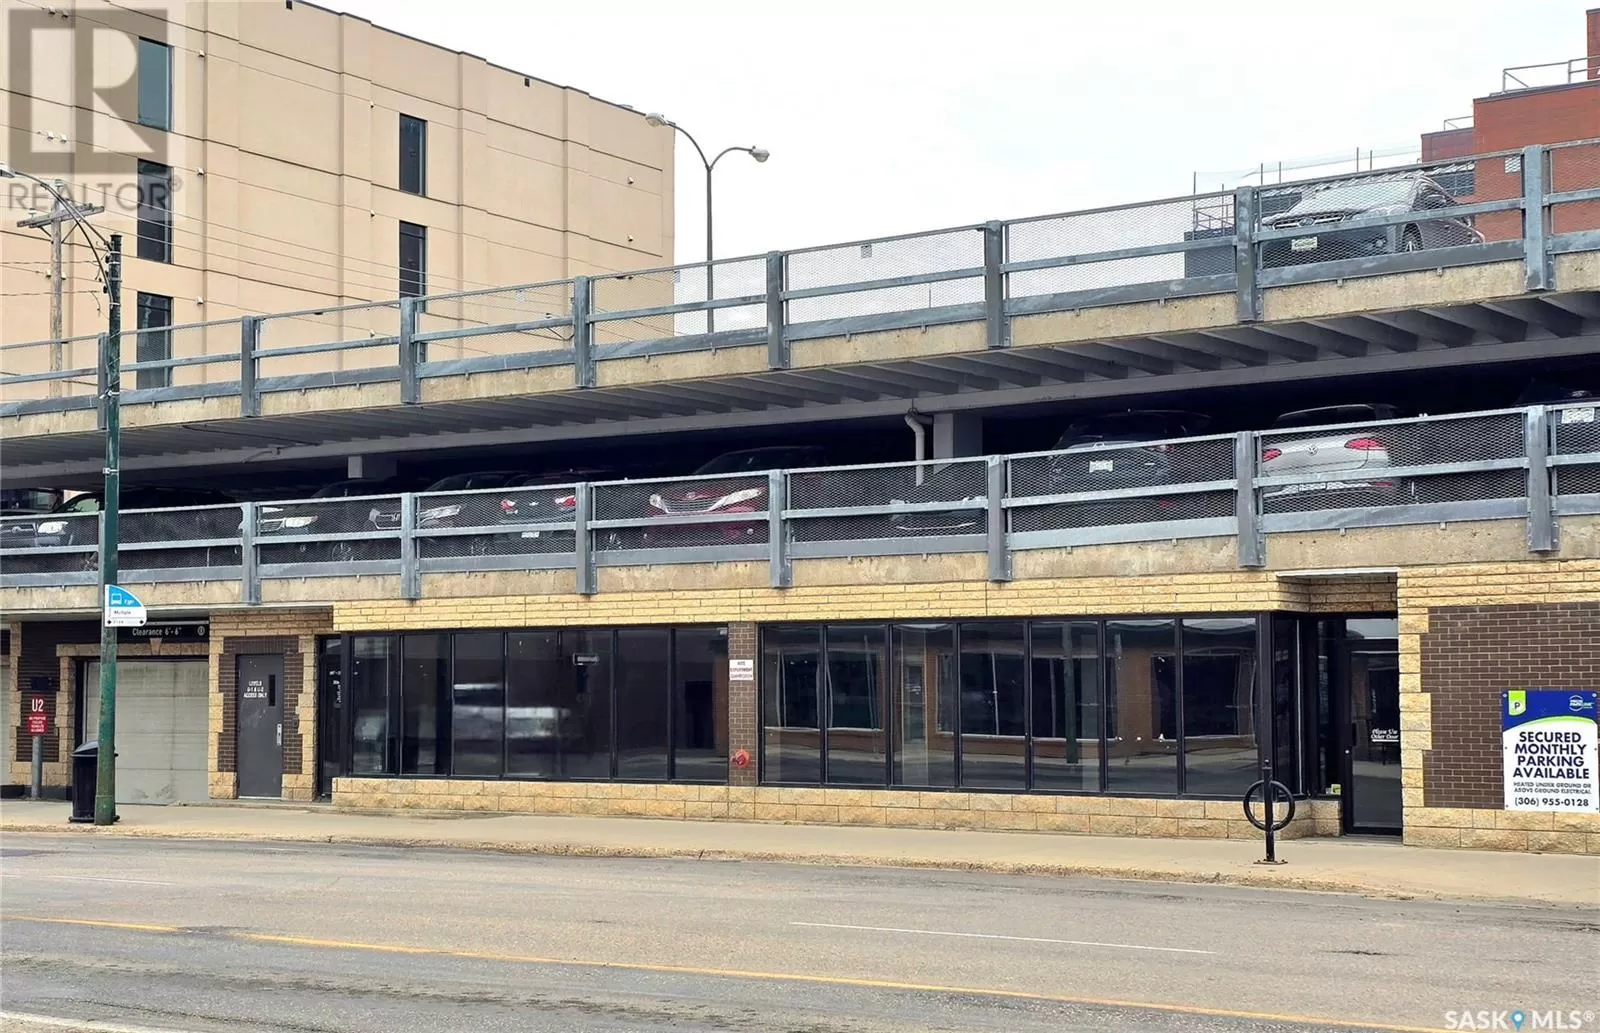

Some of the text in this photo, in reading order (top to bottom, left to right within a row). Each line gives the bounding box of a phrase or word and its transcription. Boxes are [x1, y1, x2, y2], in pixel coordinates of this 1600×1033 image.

[132, 628, 163, 636] Clearance
[32, 698, 44, 712] U2
[1514, 701, 1521, 709] P
[1519, 731, 1582, 743] SECURED
[1514, 743, 1587, 755] MONTHLY
[1517, 755, 1585, 767] PARKING
[1512, 767, 1590, 779] AVAILABLE
[1514, 797, 1589, 807] (306) 955-0128
